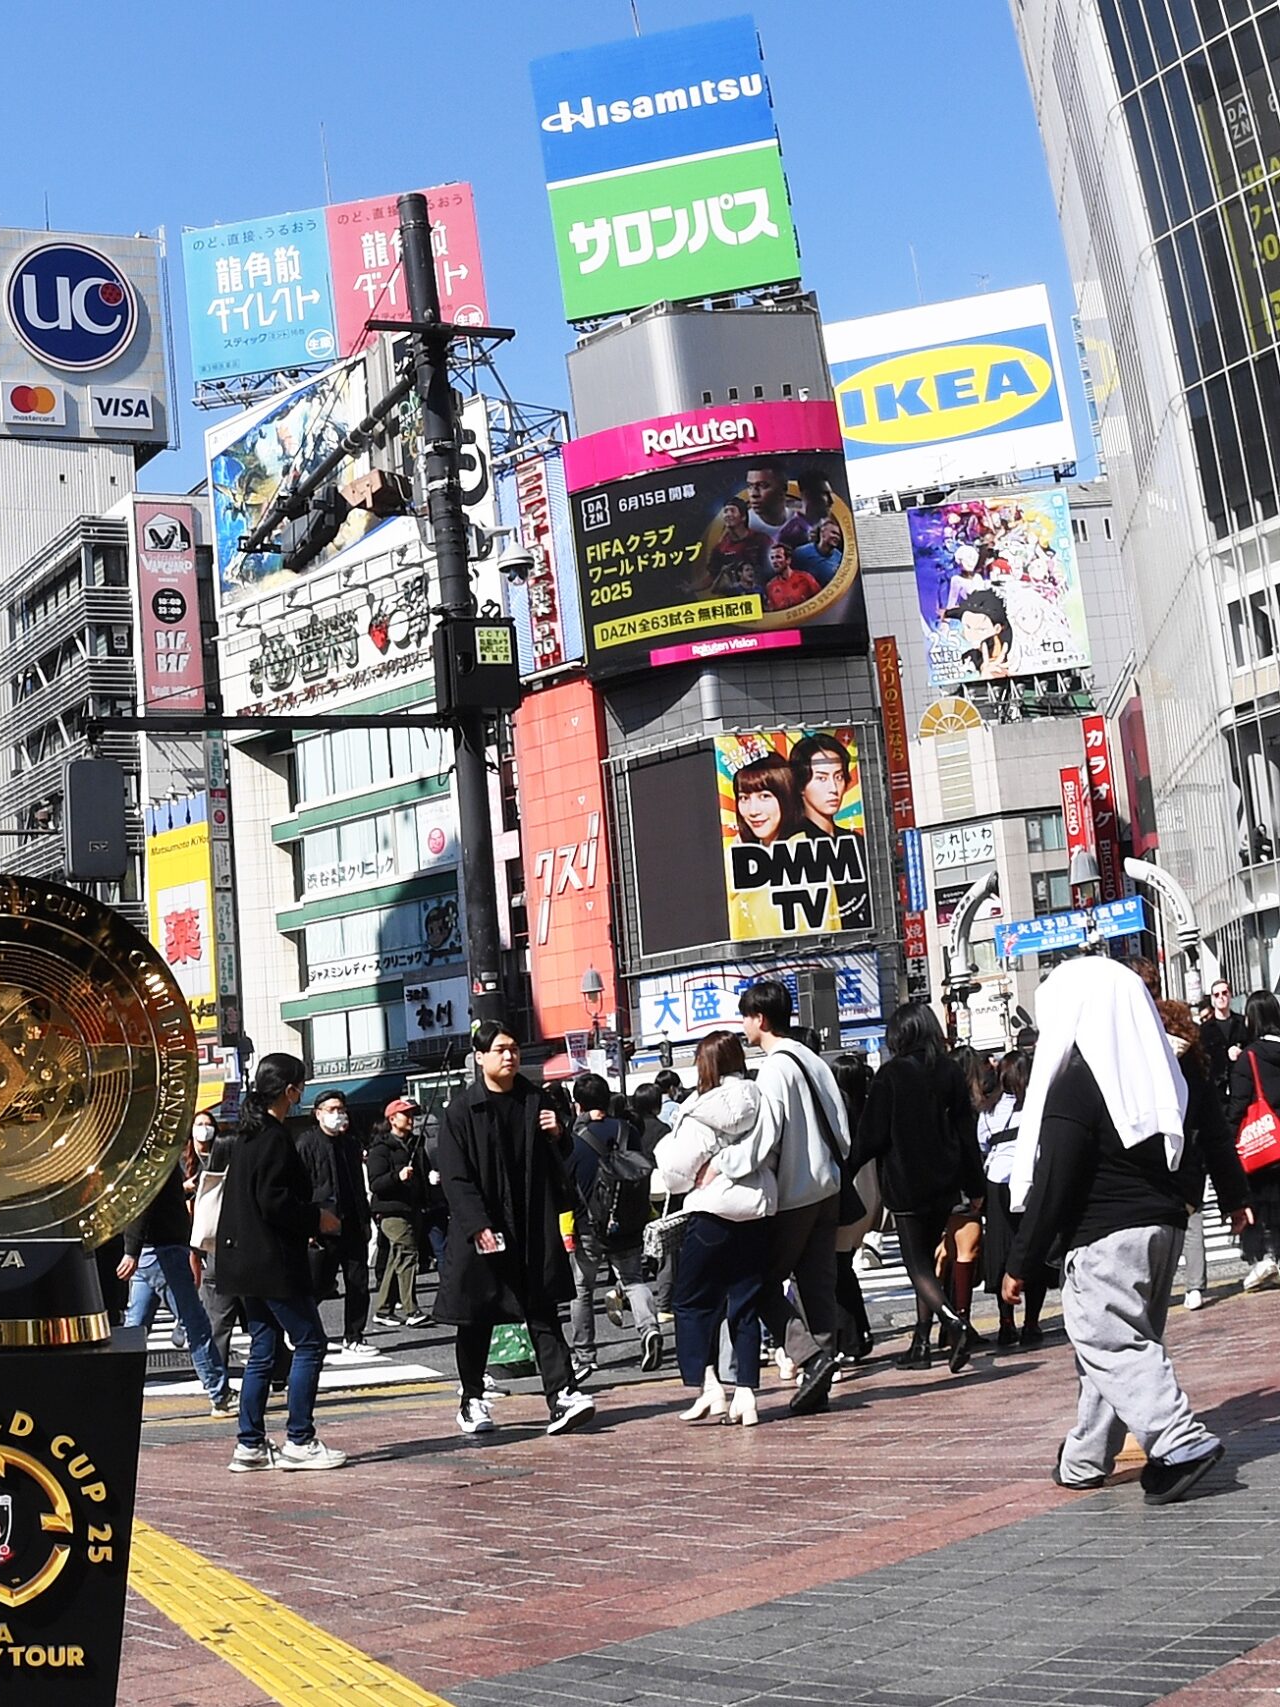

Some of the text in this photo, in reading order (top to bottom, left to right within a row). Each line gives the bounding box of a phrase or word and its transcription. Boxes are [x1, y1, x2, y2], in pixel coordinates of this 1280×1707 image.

[541, 73, 763, 133] Hisamitsu
[568, 187, 779, 275] サロンパス
[214, 244, 302, 294] 龍角散
[12, 396, 150, 423] mastercard VISA
[839, 359, 1039, 428] IKEA
[642, 417, 755, 456] Rakuten
[618, 489, 666, 512] 6月15日
[588, 542, 703, 583] ワールドカップ
[590, 581, 633, 607] 2025
[729, 638, 758, 650] Vision
[1086, 729, 1113, 828] カラオケ
[936, 844, 993, 865] クリニック
[949, 827, 992, 846] れいわ
[731, 837, 863, 890] DMM
[772, 888, 828, 931] TV
[163, 906, 203, 965] 薬
[309, 951, 423, 982] ジャスミンレディースクリニック
[653, 966, 863, 1029] 大盛店
[49, 1433, 108, 1505] CUP
[86, 1522, 114, 1565] 25
[7, 1646, 86, 1668] TOUR
